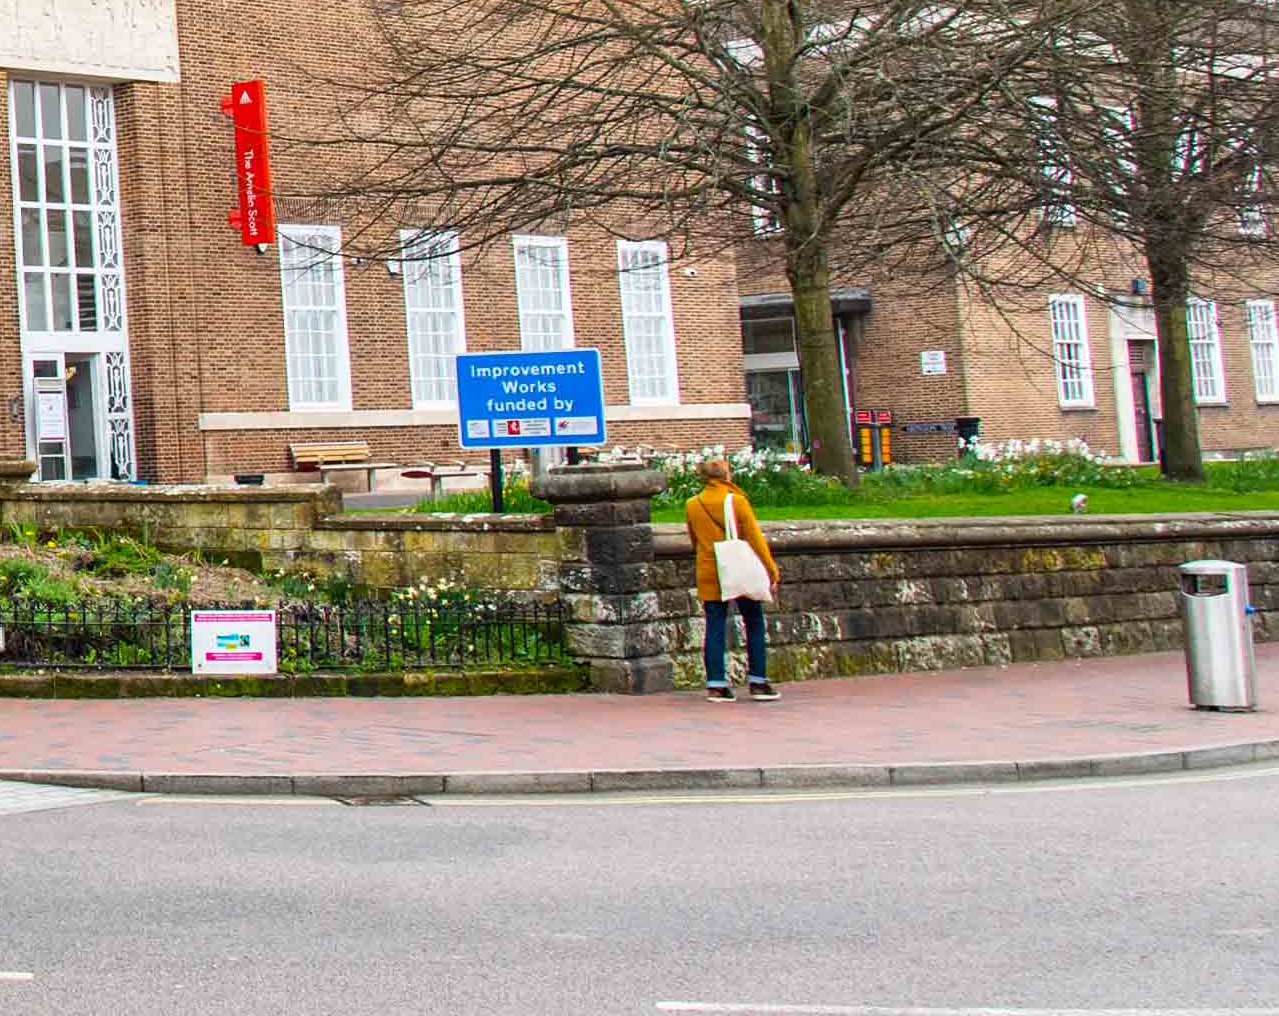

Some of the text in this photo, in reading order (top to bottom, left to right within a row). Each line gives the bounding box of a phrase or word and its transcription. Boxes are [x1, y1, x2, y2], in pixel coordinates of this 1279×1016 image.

[243, 149, 254, 168] The
[248, 209, 258, 236] Scott
[470, 361, 585, 379] Improvement
[502, 380, 557, 393] Works
[487, 395, 574, 412] funded by
